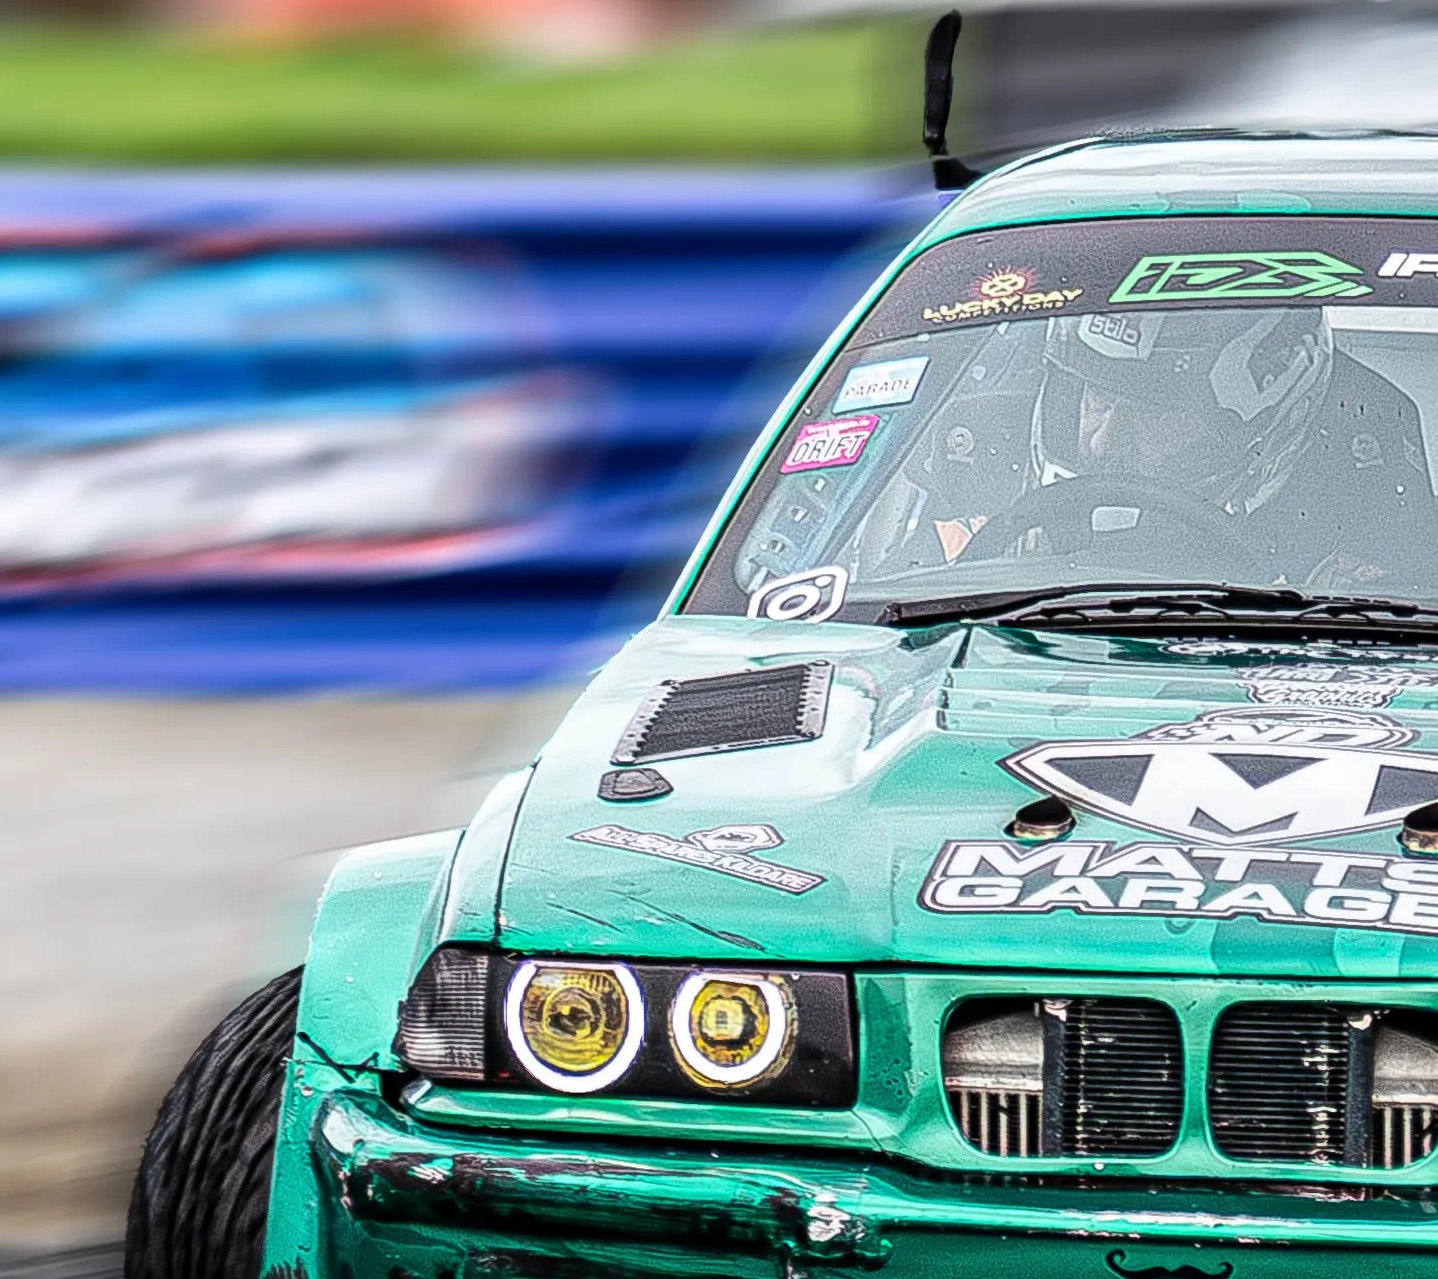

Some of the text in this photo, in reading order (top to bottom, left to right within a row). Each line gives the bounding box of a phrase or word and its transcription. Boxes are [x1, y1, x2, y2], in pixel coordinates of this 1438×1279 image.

[923, 288, 1083, 320] LUCKY DAY
[792, 434, 865, 463] DRIFT
[715, 855, 813, 890] KILDARE
